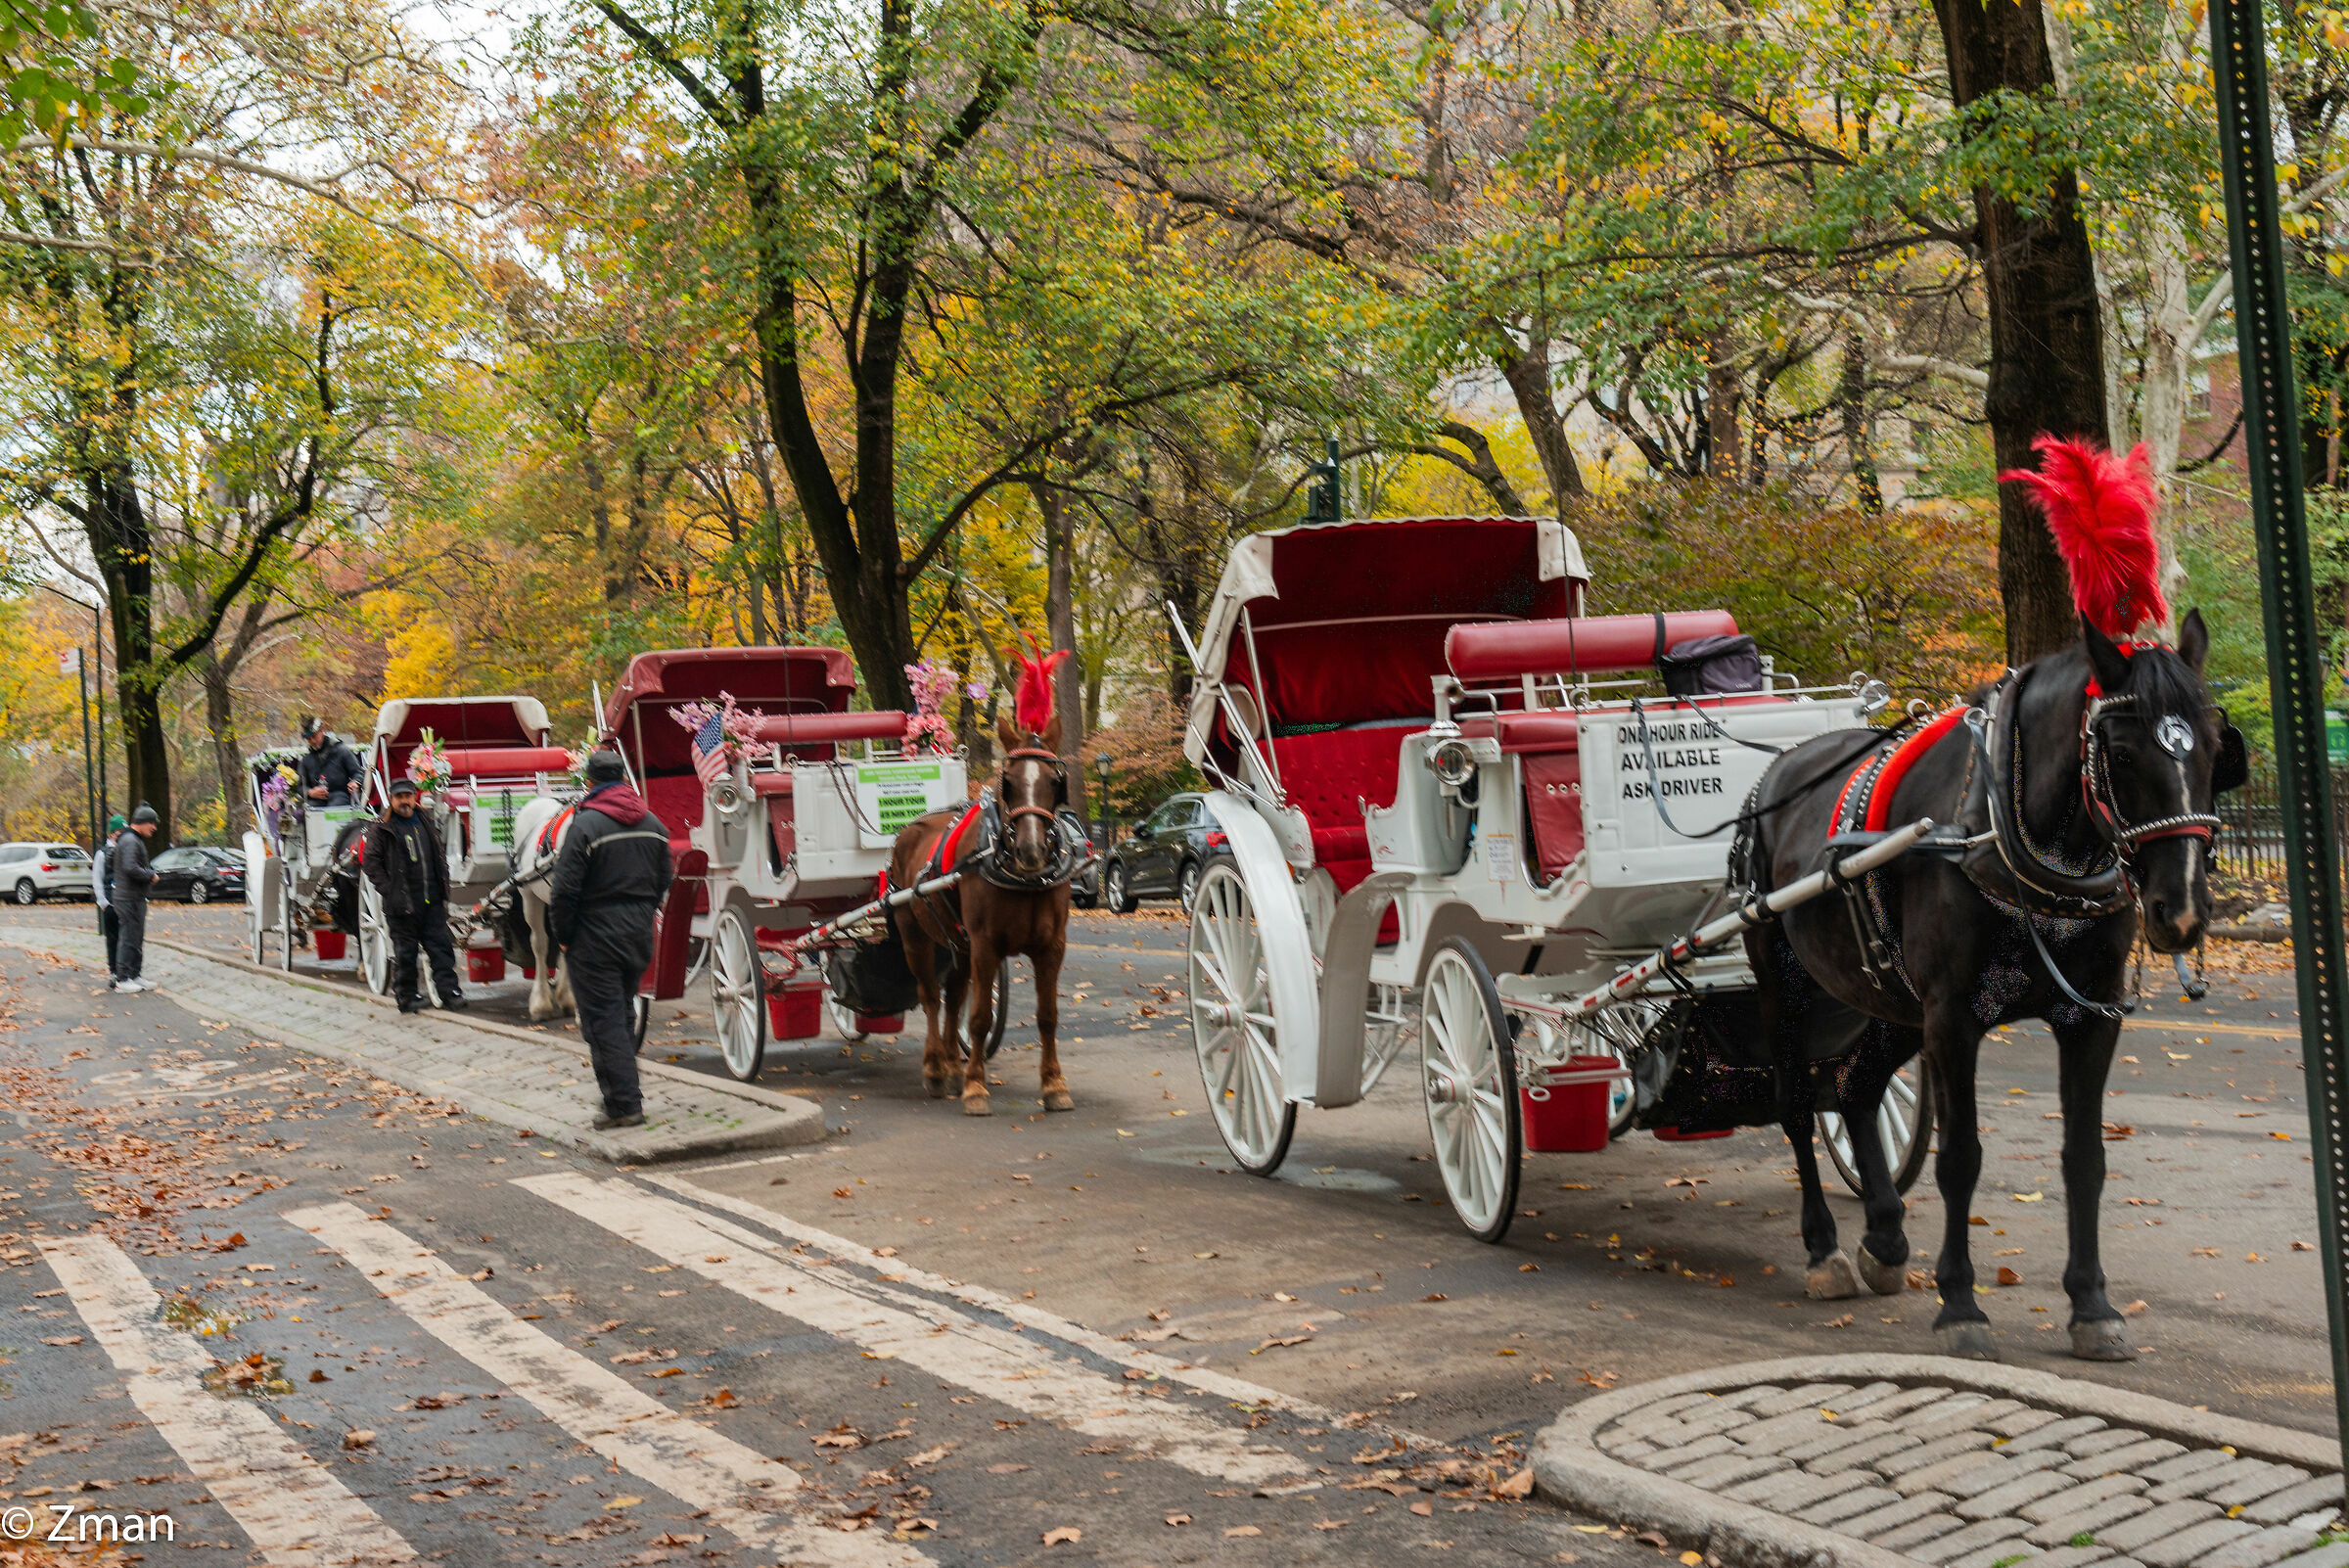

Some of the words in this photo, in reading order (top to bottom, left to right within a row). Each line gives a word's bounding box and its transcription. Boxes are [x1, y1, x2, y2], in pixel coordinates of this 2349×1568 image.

[1649, 723, 1685, 742] HOUR
[1623, 781, 1656, 800] ASK
[1661, 778, 1723, 796] DRIVER
